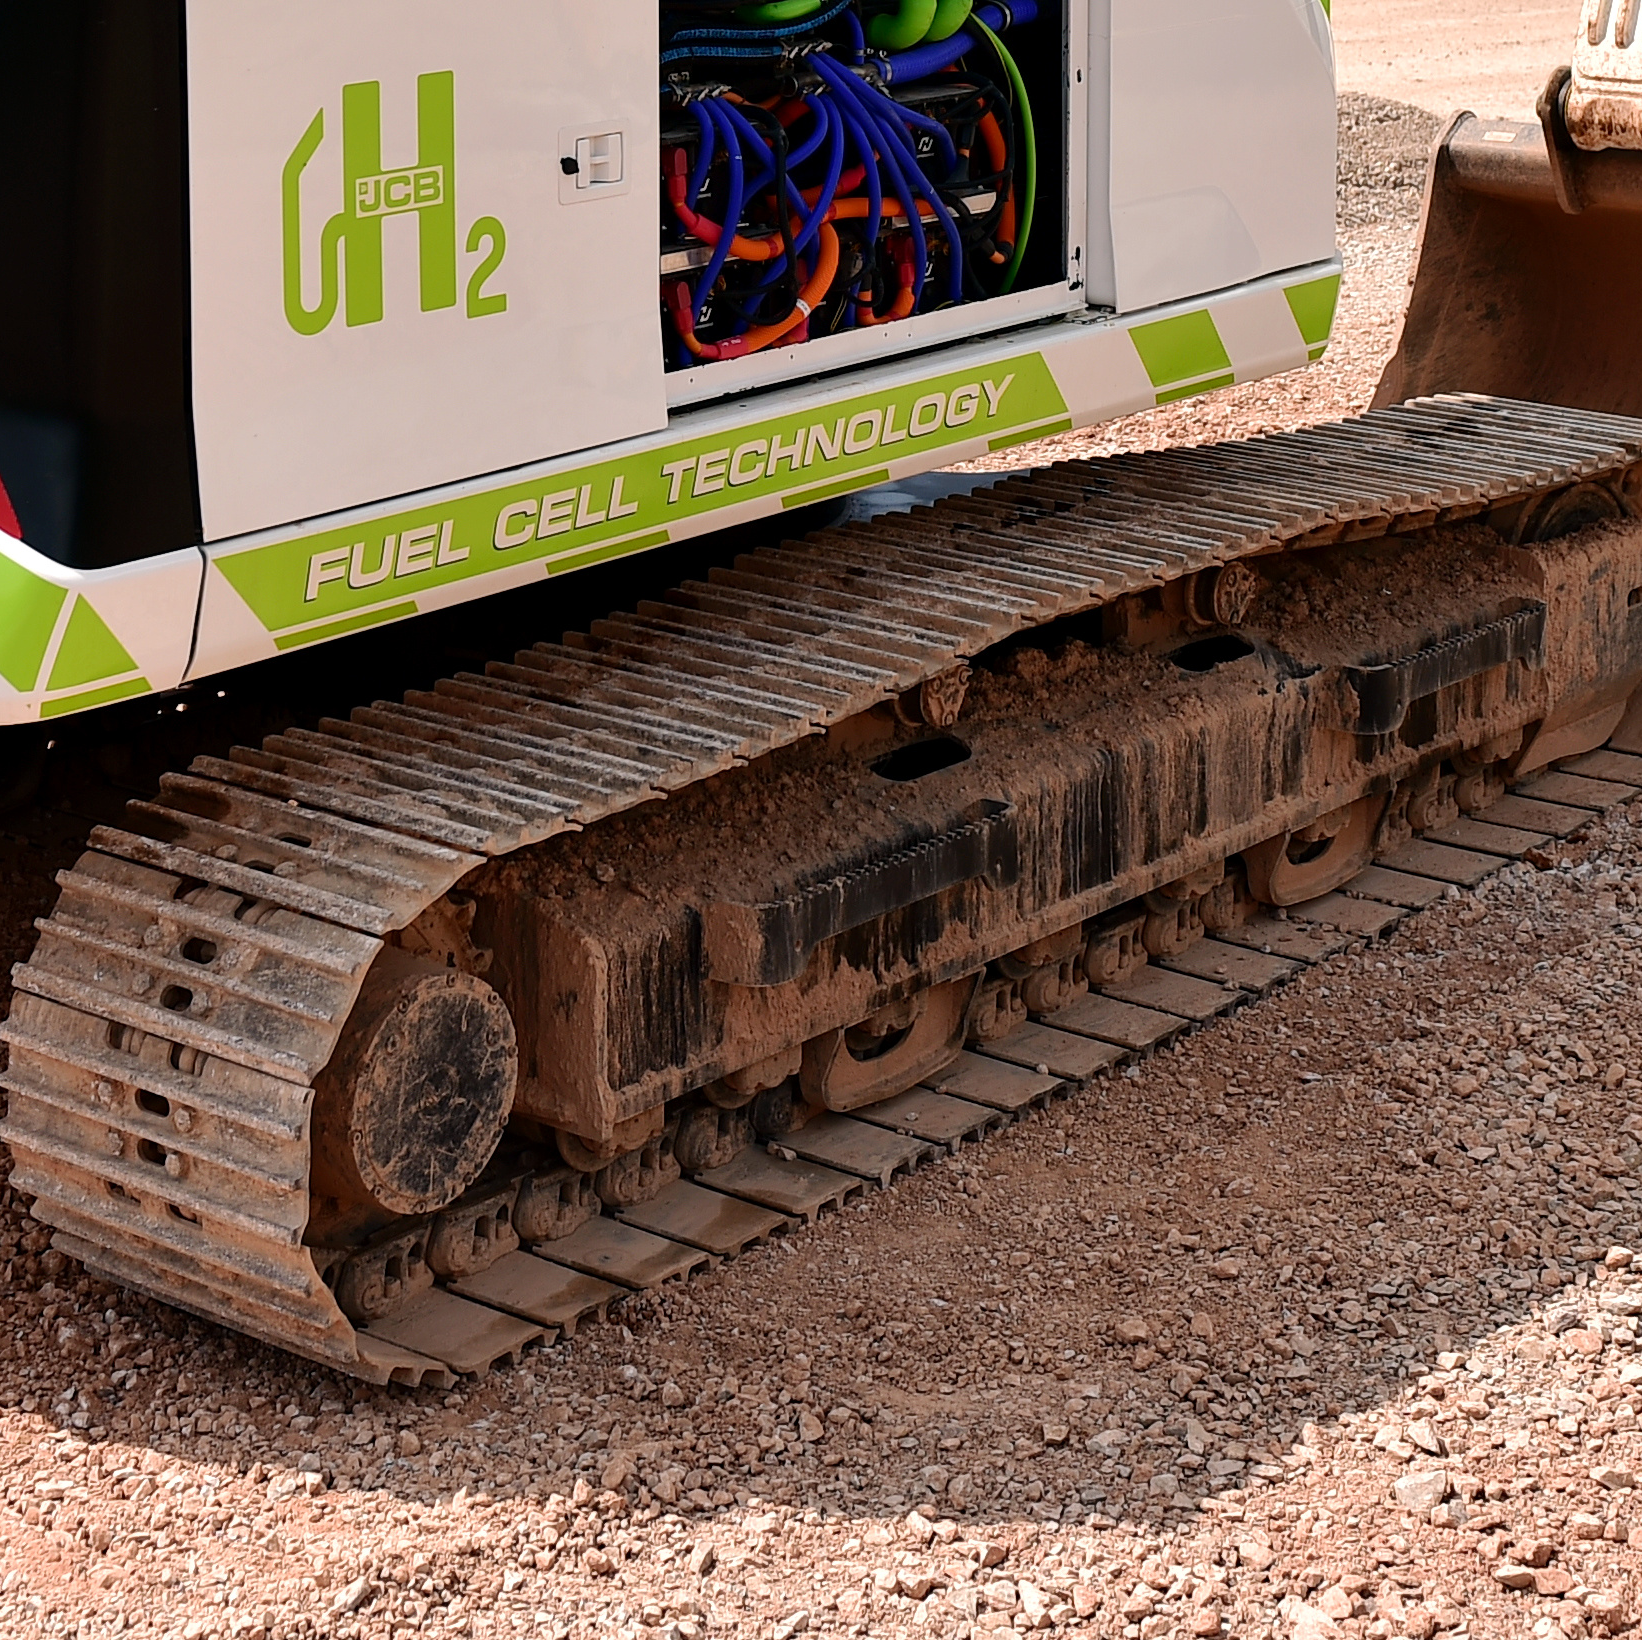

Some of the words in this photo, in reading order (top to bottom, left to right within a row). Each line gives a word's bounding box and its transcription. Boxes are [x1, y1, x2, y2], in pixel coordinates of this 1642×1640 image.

[359, 170, 441, 213] JCB
[303, 522, 470, 603] FUEL
[492, 475, 639, 552] CELL
[661, 372, 1015, 506] TECHNOLOGY
